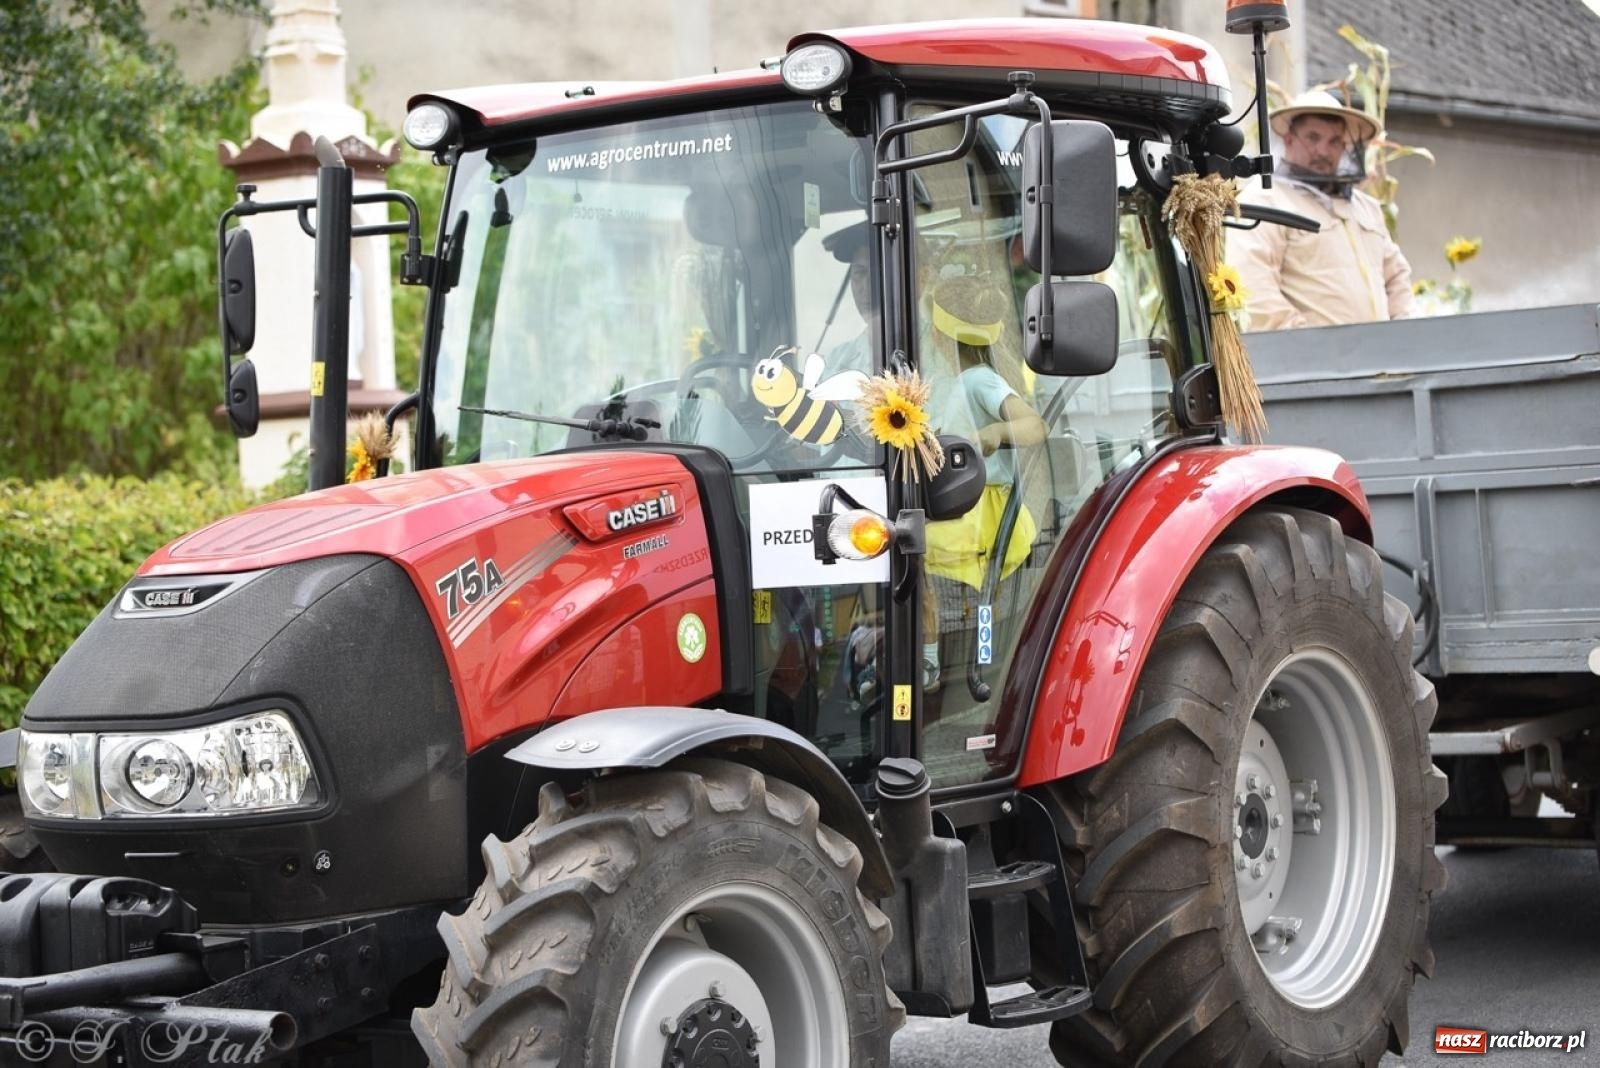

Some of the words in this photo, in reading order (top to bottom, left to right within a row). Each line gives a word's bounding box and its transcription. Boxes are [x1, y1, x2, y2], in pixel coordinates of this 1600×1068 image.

[547, 133, 732, 172] www.agrocentrum.net
[608, 499, 661, 531] CASE
[623, 533, 669, 561] FARMALL
[144, 591, 181, 606] CASE
[435, 556, 507, 620] 75A
